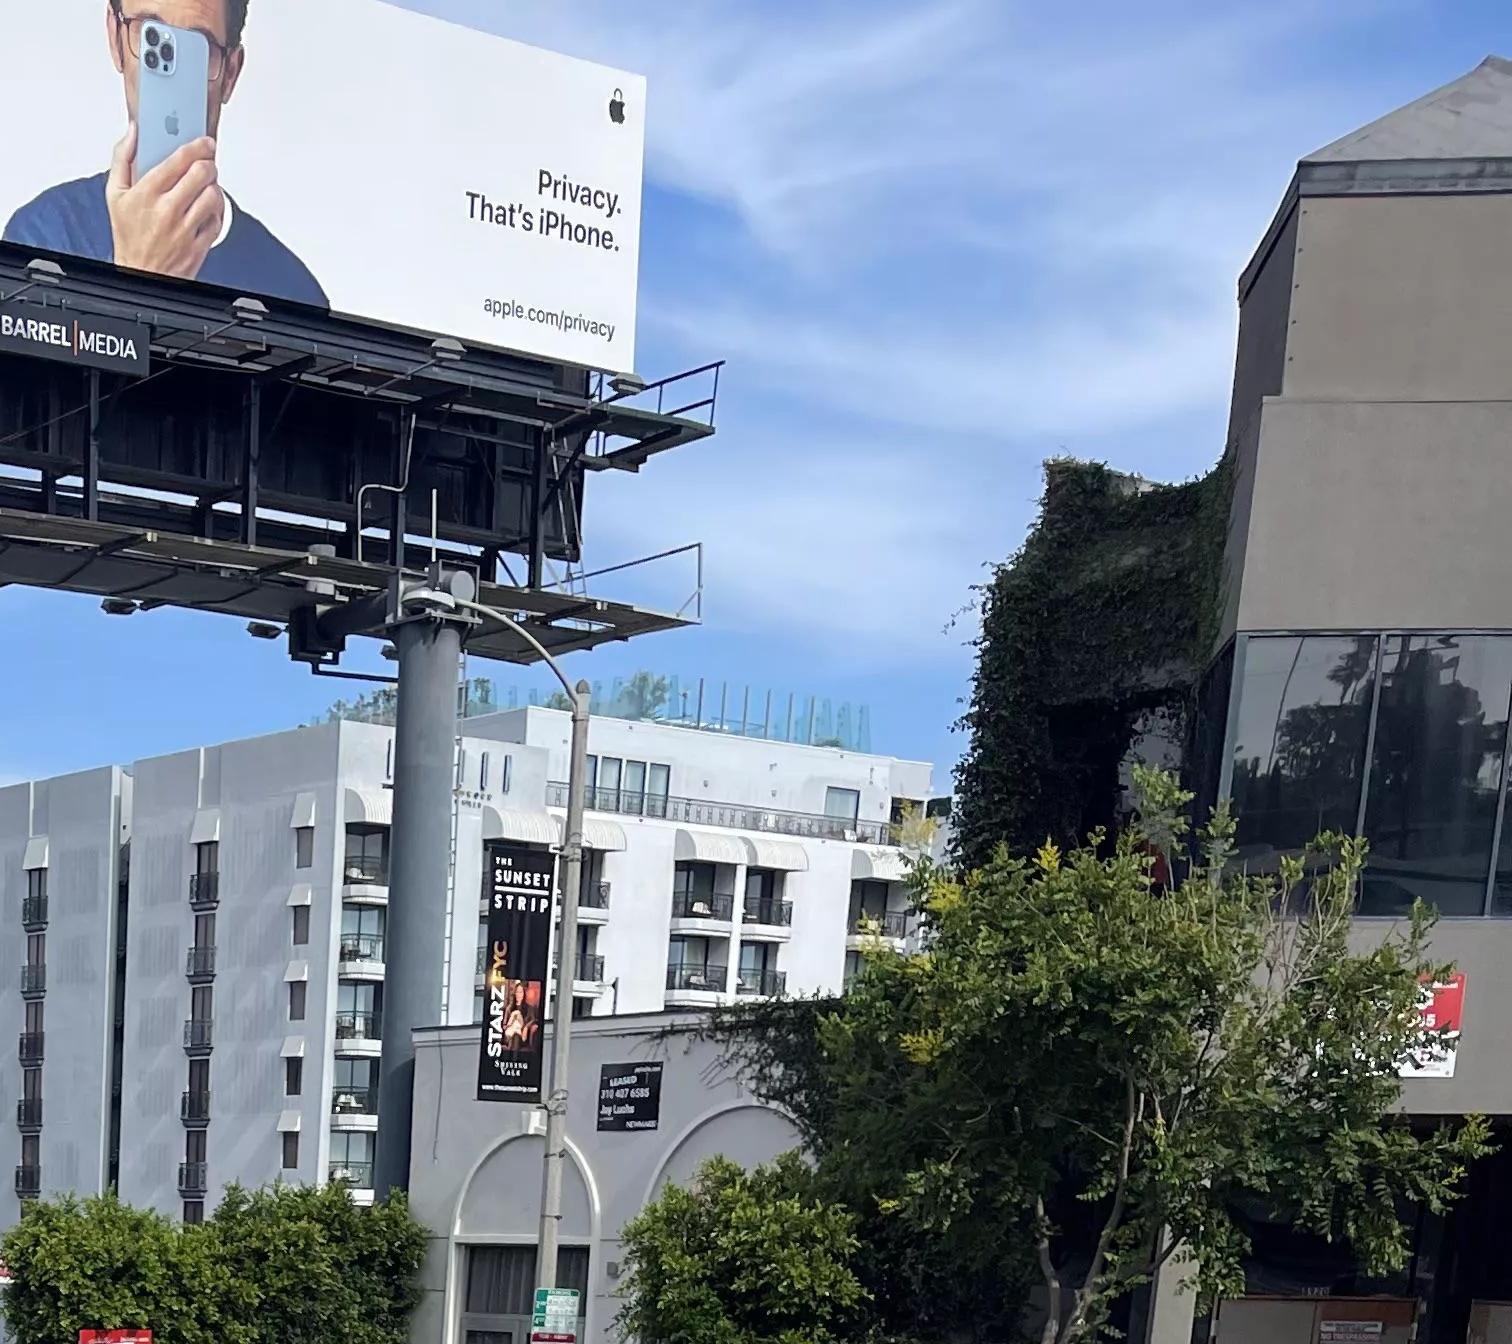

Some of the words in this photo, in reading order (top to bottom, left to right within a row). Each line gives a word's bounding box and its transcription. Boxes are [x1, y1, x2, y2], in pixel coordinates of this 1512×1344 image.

[538, 169, 621, 218] Privacy.
[465, 191, 534, 232] That's
[538, 208, 620, 252] iPhone.
[1, 315, 72, 347] BARREL
[78, 330, 138, 361] MEDIA
[483, 298, 616, 342] apple.com/privacy
[494, 869, 551, 887] SUNSET
[495, 856, 513, 867] THE
[494, 893, 549, 913] STRIP
[492, 940, 508, 983] FYC
[487, 985, 505, 1058] STARZ
